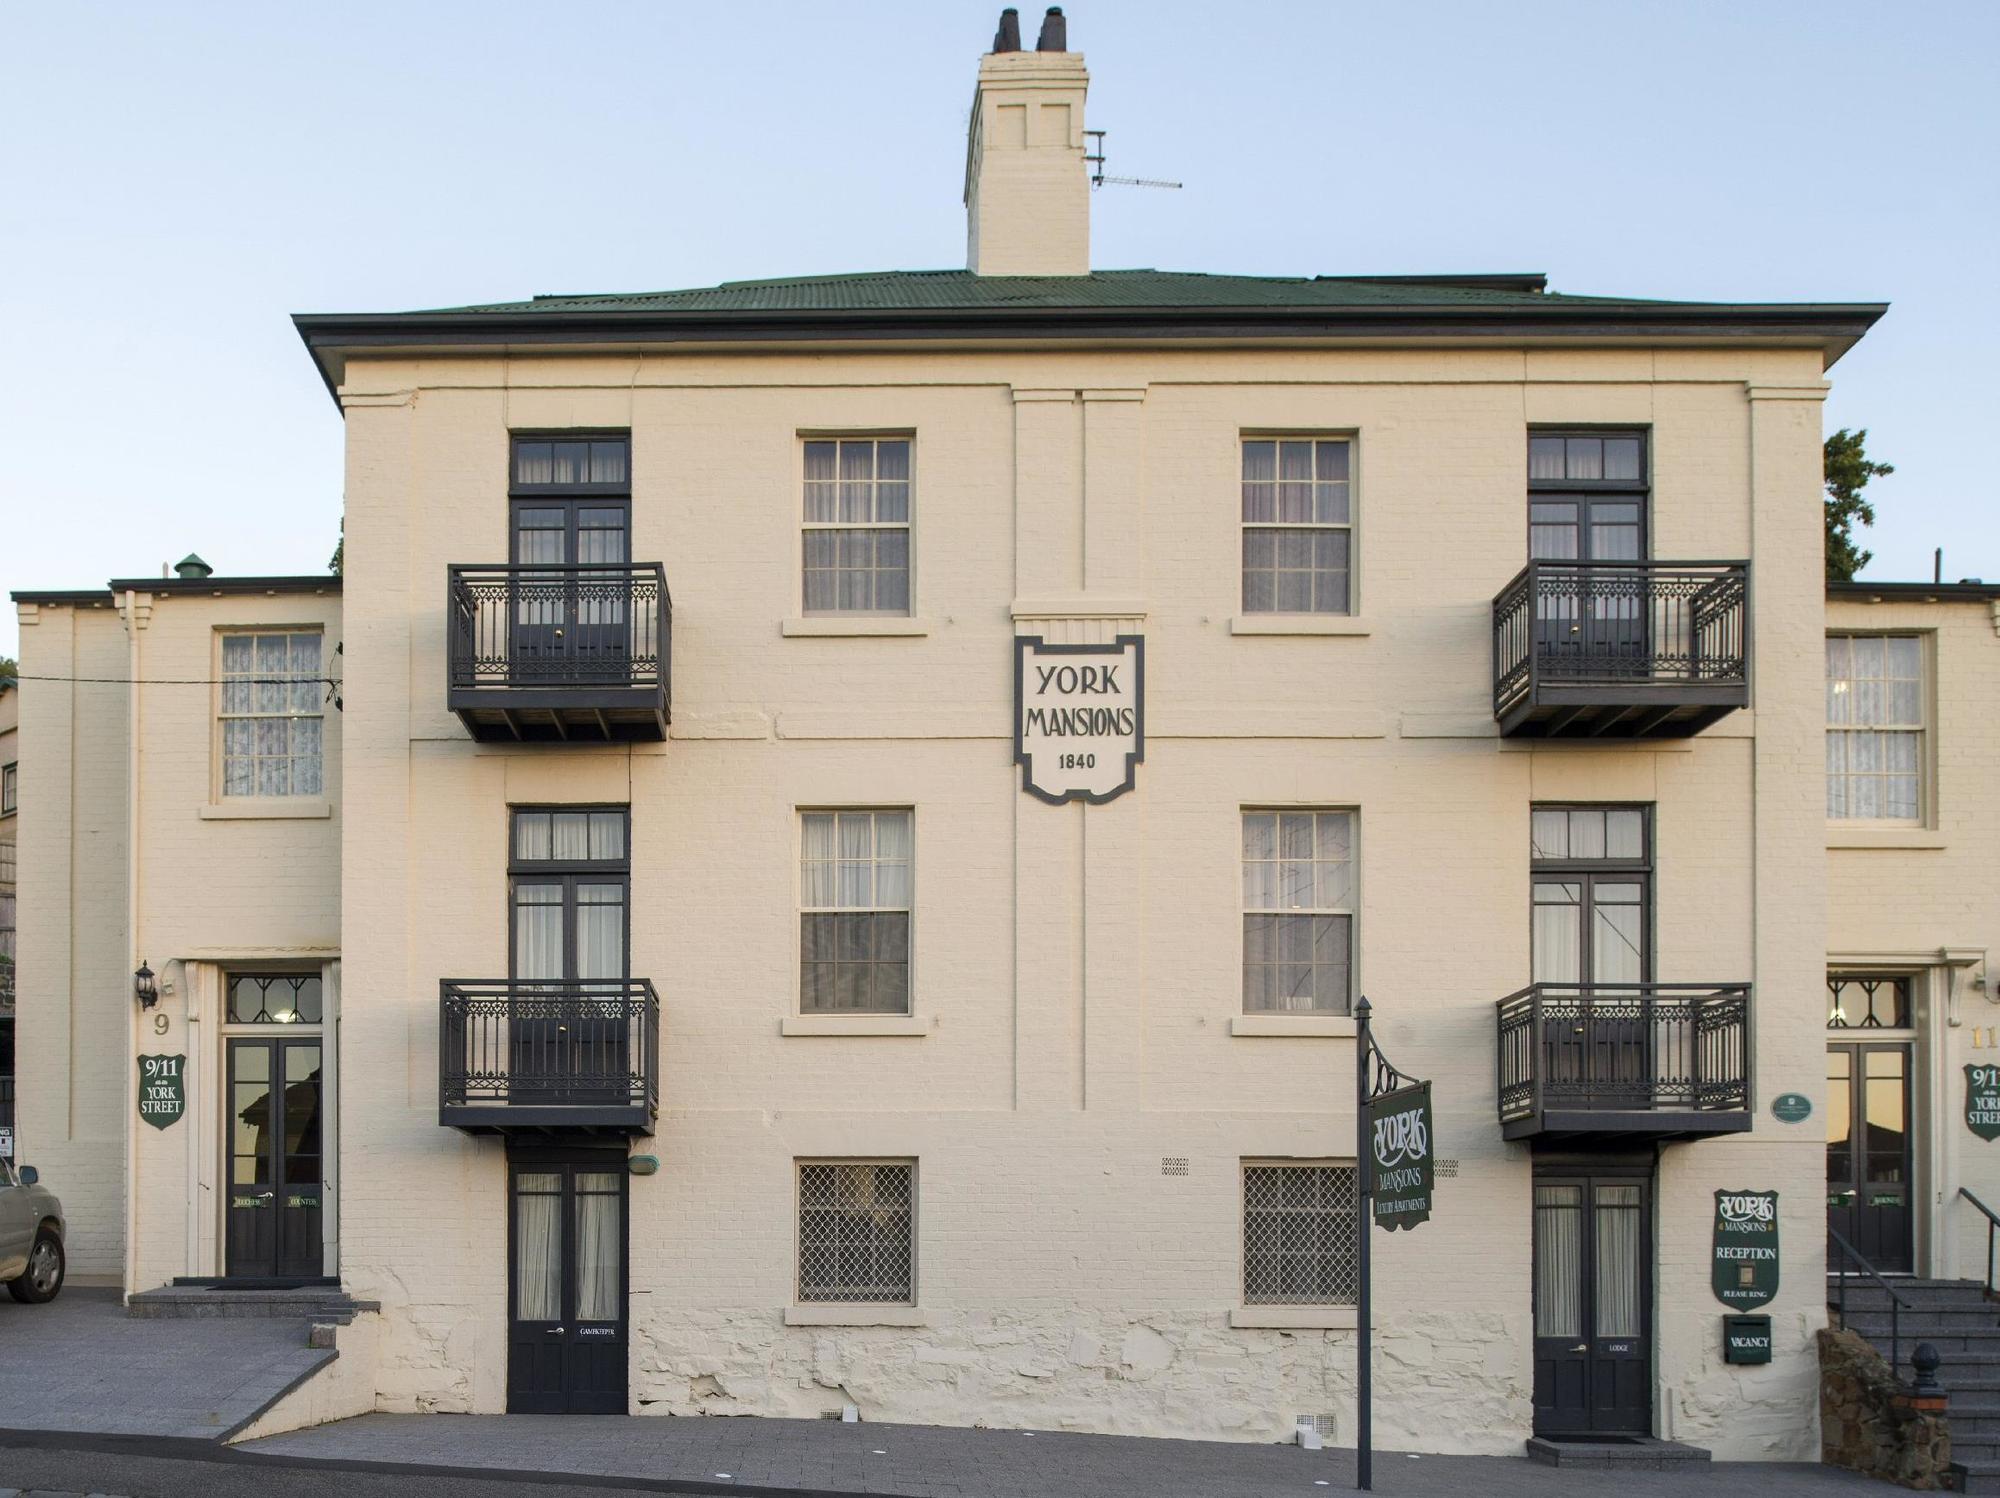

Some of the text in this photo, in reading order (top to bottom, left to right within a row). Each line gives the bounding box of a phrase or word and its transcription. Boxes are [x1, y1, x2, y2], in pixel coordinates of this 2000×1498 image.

[1036, 665, 1121, 694] YORK
[1024, 707, 1134, 737] MANSIONS
[1059, 753, 1096, 769] 1840
[154, 1013, 170, 1035] 9
[1971, 1026, 1998, 1049] 11
[145, 1059, 178, 1078] 9/11
[147, 1086, 176, 1099] YORK
[141, 1100, 181, 1113] STREET
[1374, 1108, 1427, 1167] YORK
[1379, 1167, 1421, 1192] MANSIONS
[1394, 1197, 1426, 1213] APARTMENTS
[1719, 1196, 1774, 1222] YORK
[1724, 1221, 1767, 1234] MANSIONS
[1716, 1247, 1776, 1260] RECEPTION
[1749, 1290, 1768, 1298] RING
[1609, 1344, 1629, 1352] LODGE
[1731, 1337, 1769, 1347] VACANCY
